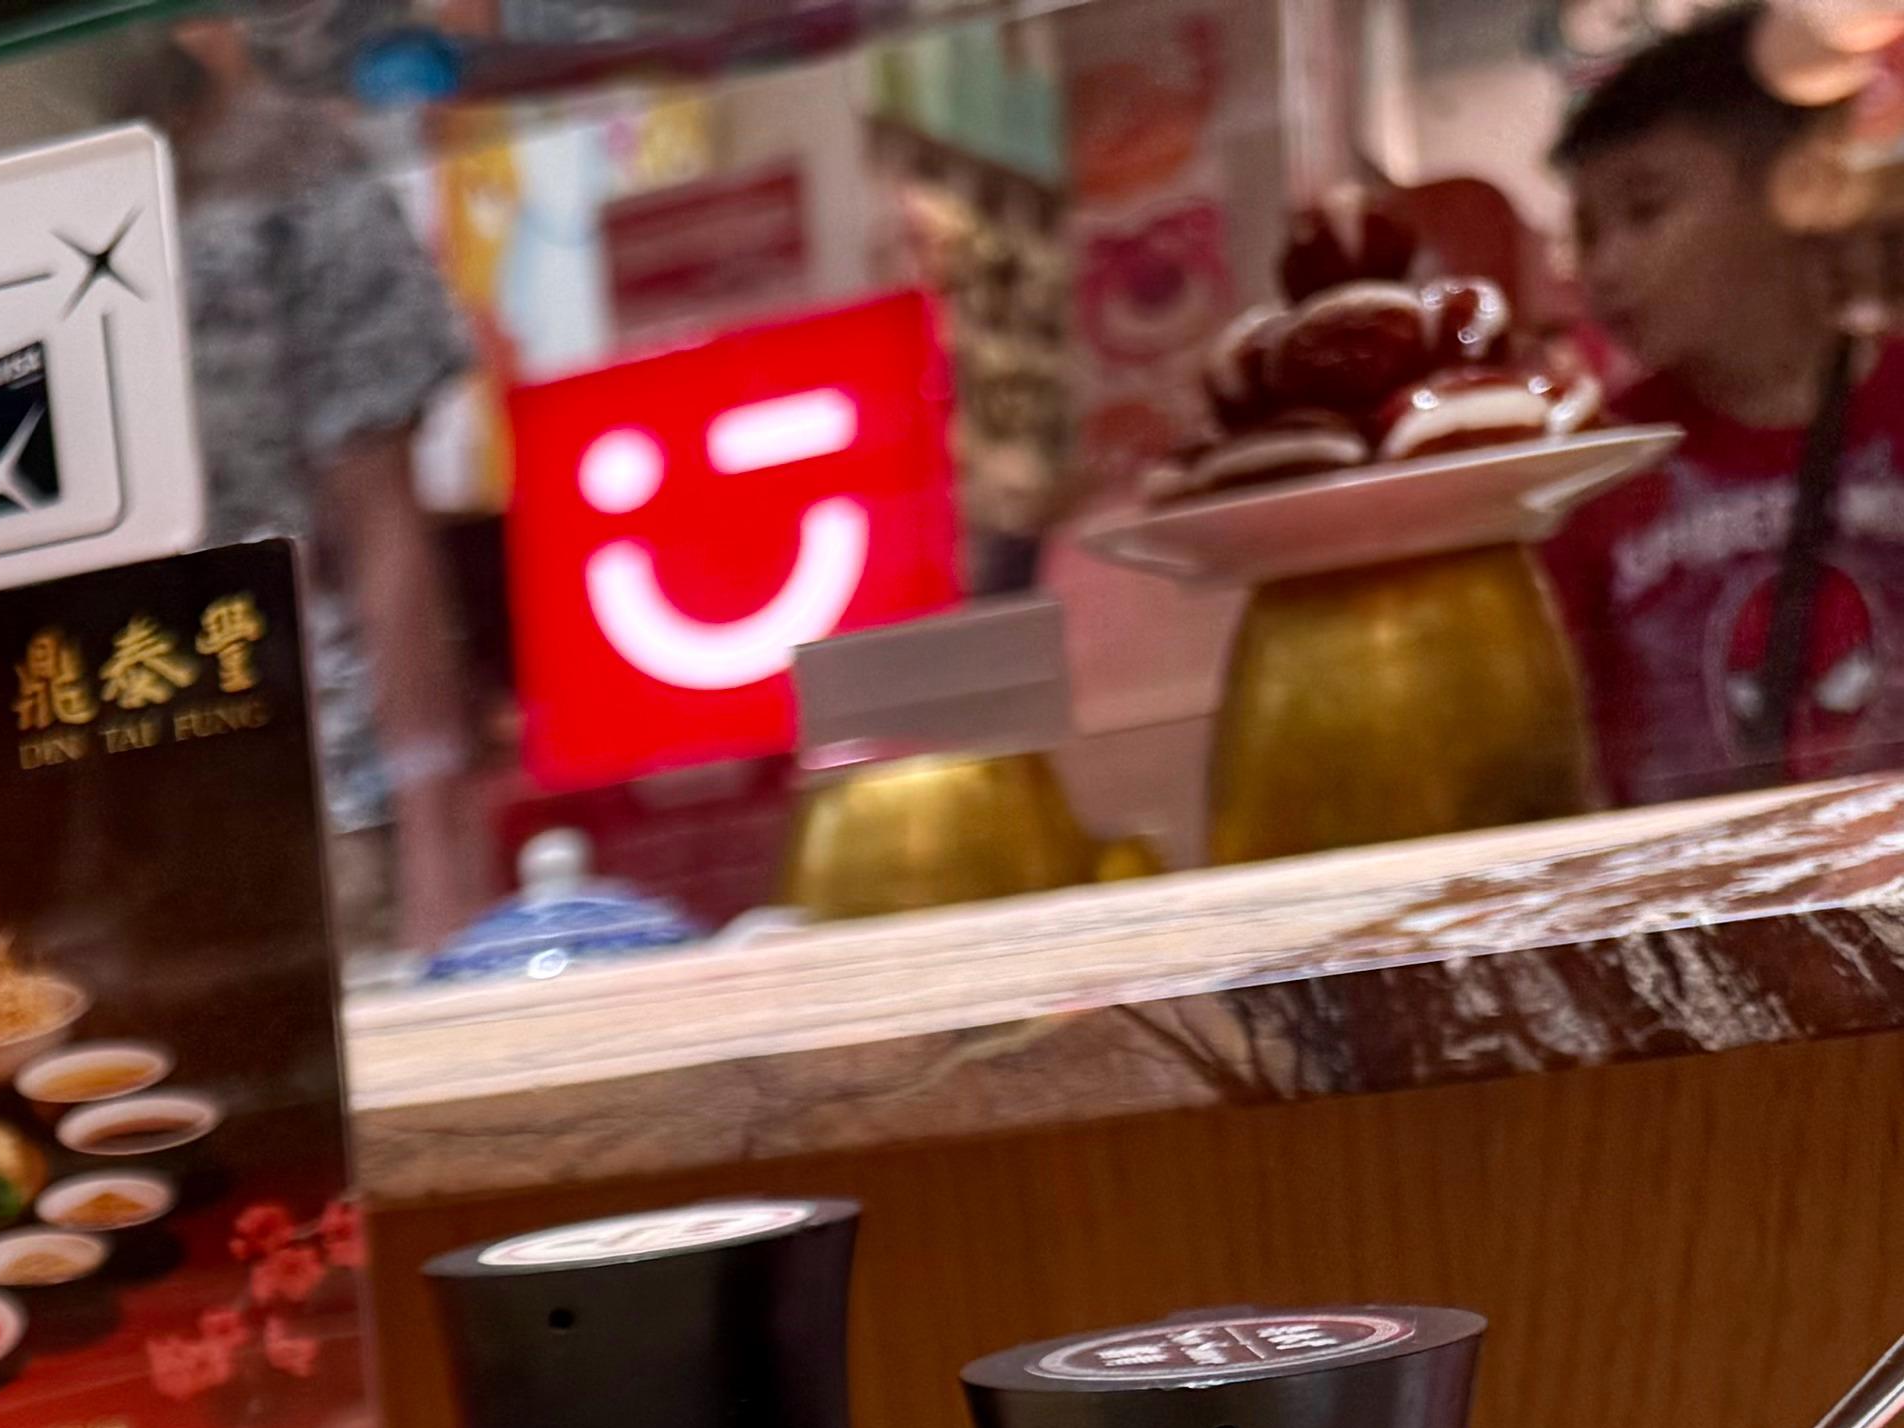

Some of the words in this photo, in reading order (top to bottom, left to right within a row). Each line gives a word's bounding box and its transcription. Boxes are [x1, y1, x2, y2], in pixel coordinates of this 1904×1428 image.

[13, 593, 266, 730] 鼎泰豐
[20, 736, 86, 769] DIN
[102, 723, 160, 753] TAI
[174, 702, 271, 741] FUNG
